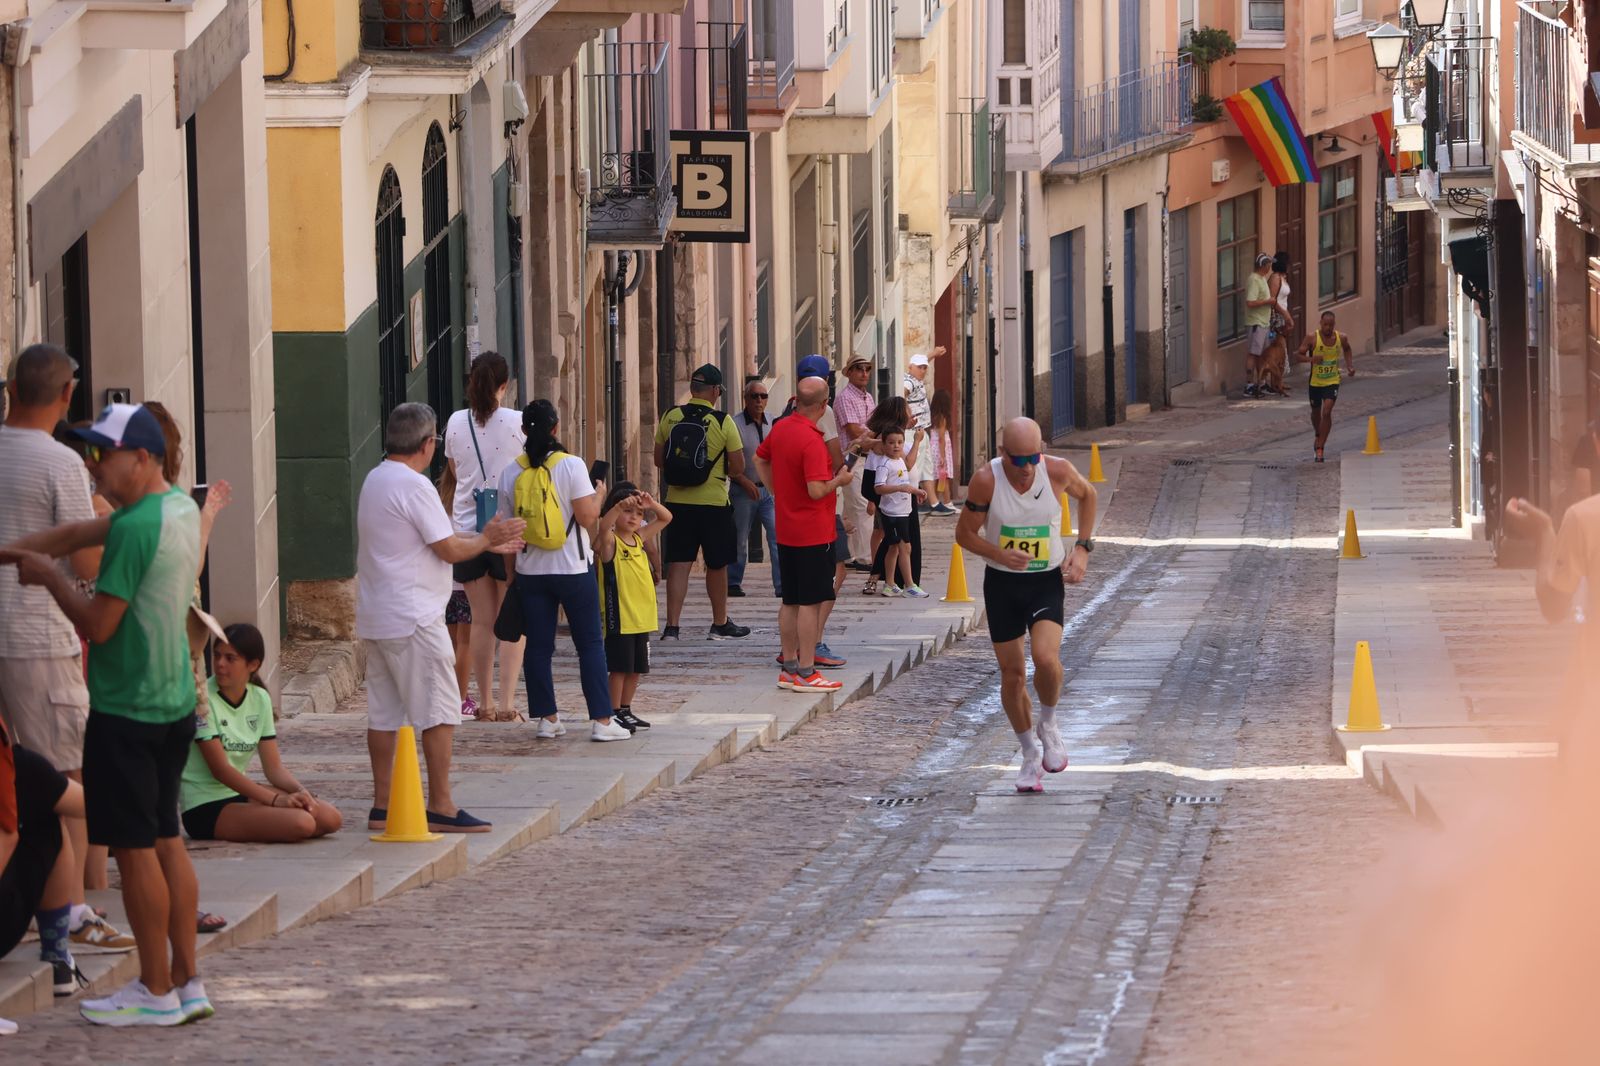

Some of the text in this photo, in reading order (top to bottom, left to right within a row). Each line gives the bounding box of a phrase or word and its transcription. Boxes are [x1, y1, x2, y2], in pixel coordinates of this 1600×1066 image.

[683, 164, 728, 210] B
[1318, 366, 1334, 374] 597
[1004, 540, 1040, 558] 481
